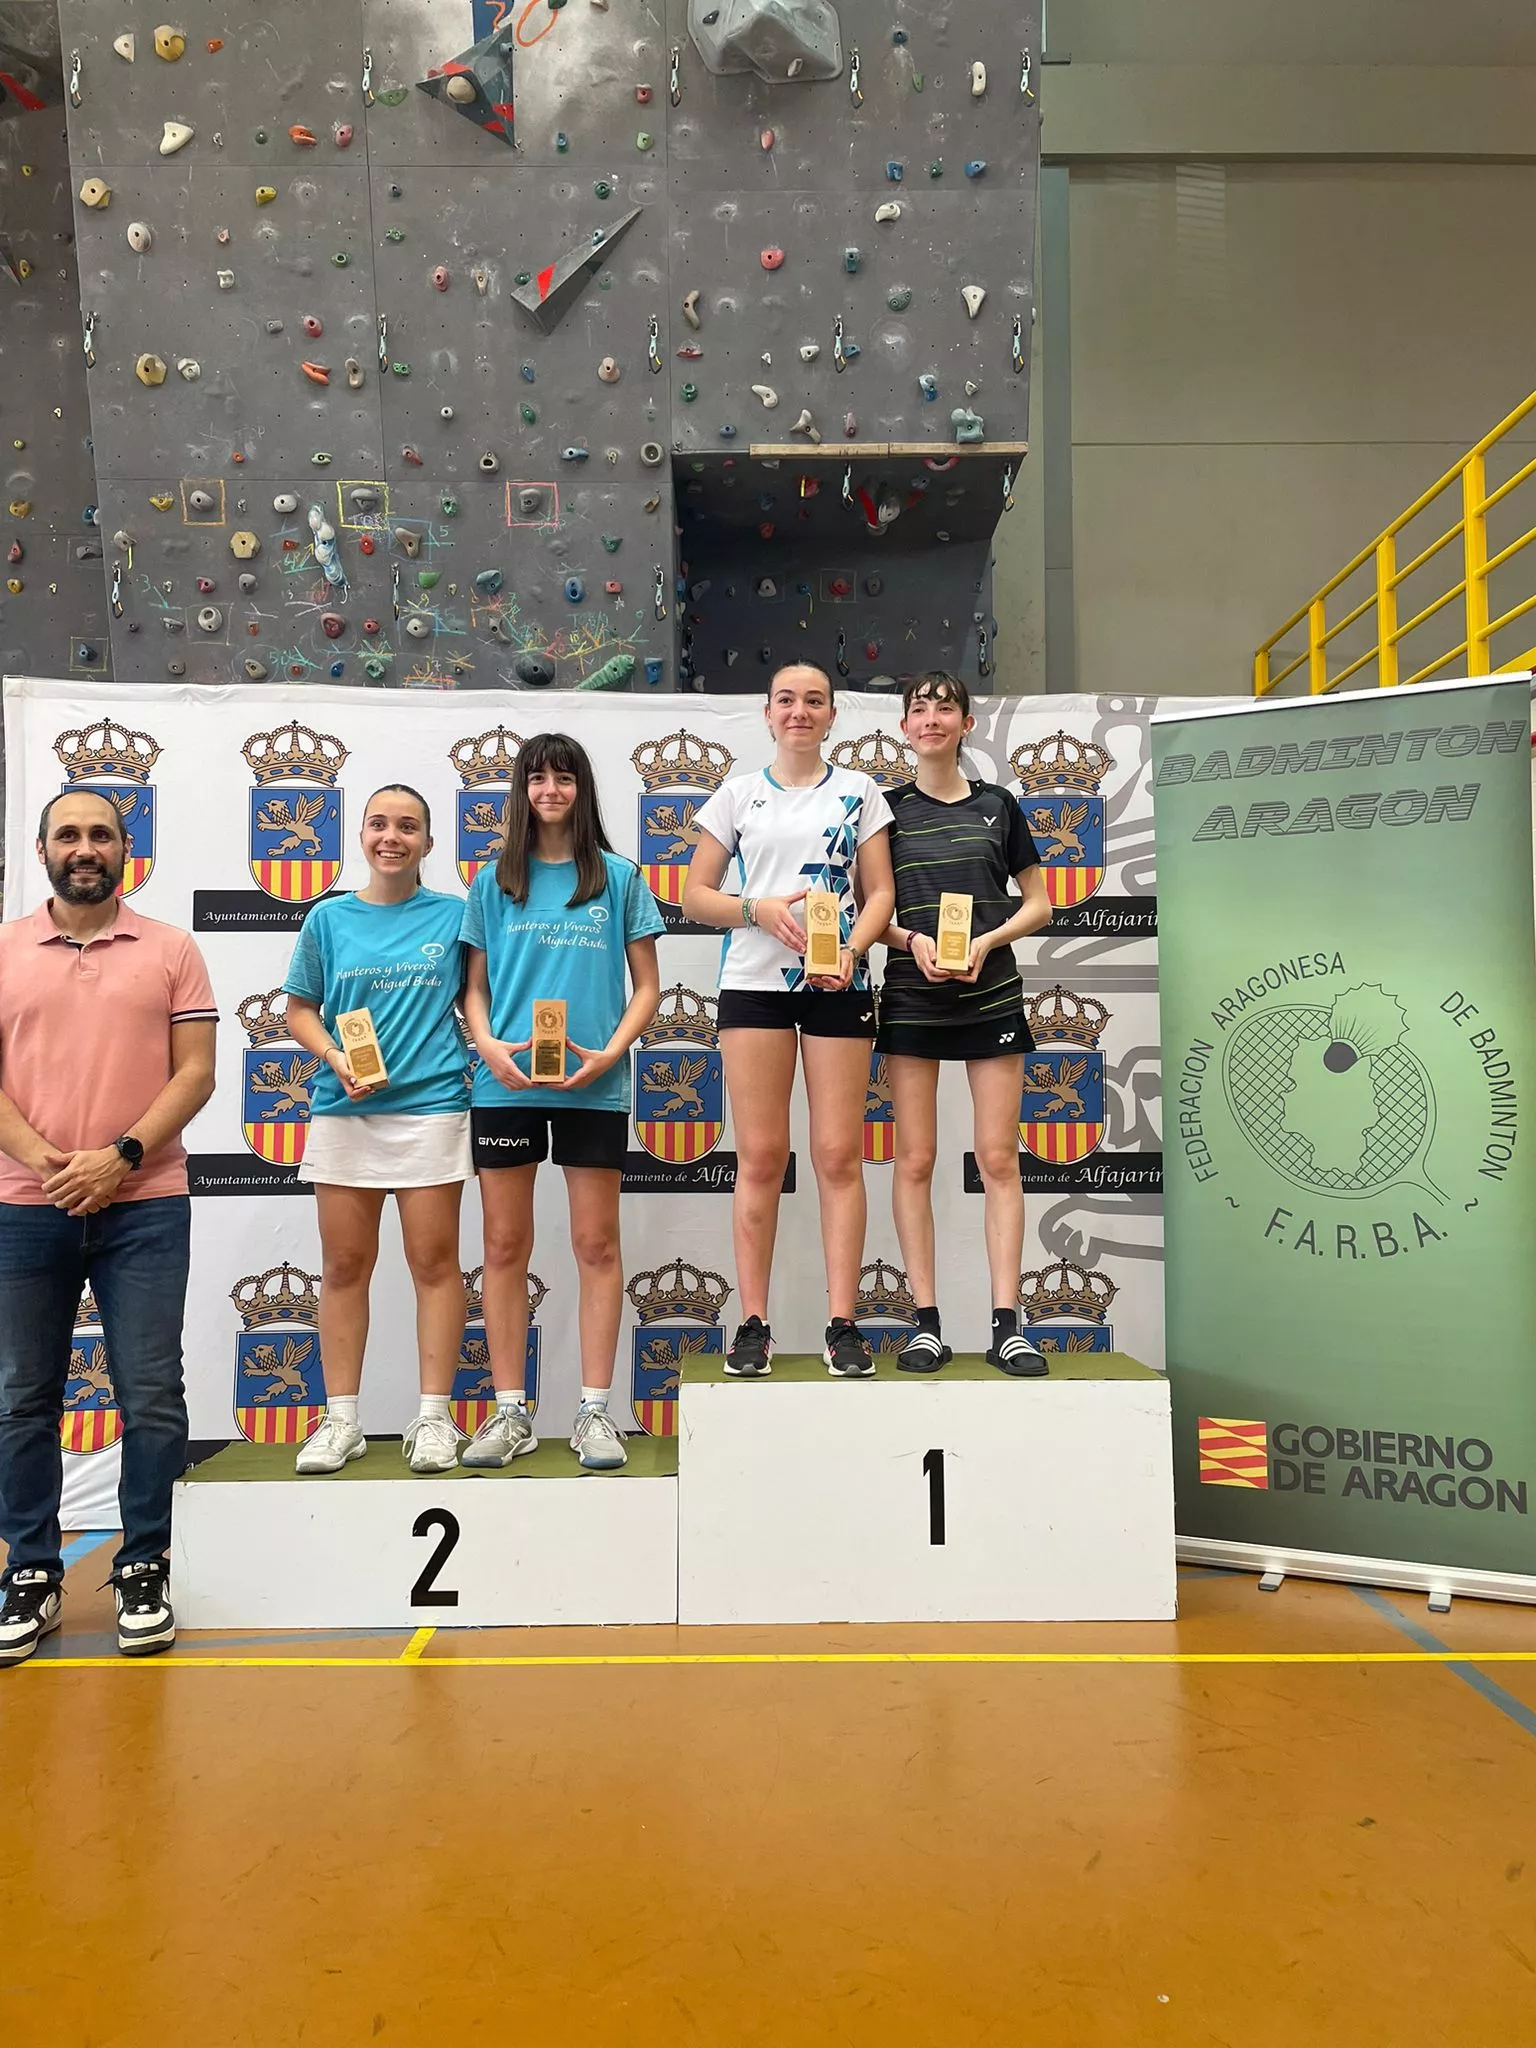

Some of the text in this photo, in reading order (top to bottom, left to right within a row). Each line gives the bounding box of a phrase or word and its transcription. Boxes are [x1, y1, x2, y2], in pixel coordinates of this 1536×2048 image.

[1156, 720, 1527, 787] BADMINTON
[1192, 783, 1481, 842] ARAGON
[202, 910, 304, 924] Ayuntamiento de
[1057, 915, 1069, 926] de
[552, 924, 561, 935] y
[563, 921, 601, 934] Viveros
[538, 934, 578, 950] Miguel
[382, 966, 392, 978] y
[396, 961, 436, 974] Viveros
[371, 975, 411, 993] Miguel
[1179, 952, 1518, 1183] FEDERACION ARAGONESA DE BADMINTON
[478, 1136, 530, 1147] GIVOVA
[194, 1173, 297, 1188] Ayuntamiento de
[622, 1164, 736, 1188] tamiento de Alfa
[1058, 1172, 1070, 1183] de
[1272, 1423, 1493, 1472] GOBIERNO
[1273, 1459, 1528, 1514] DE ARAGON
[923, 1449, 946, 1545] 1
[410, 1508, 460, 1607] 2
